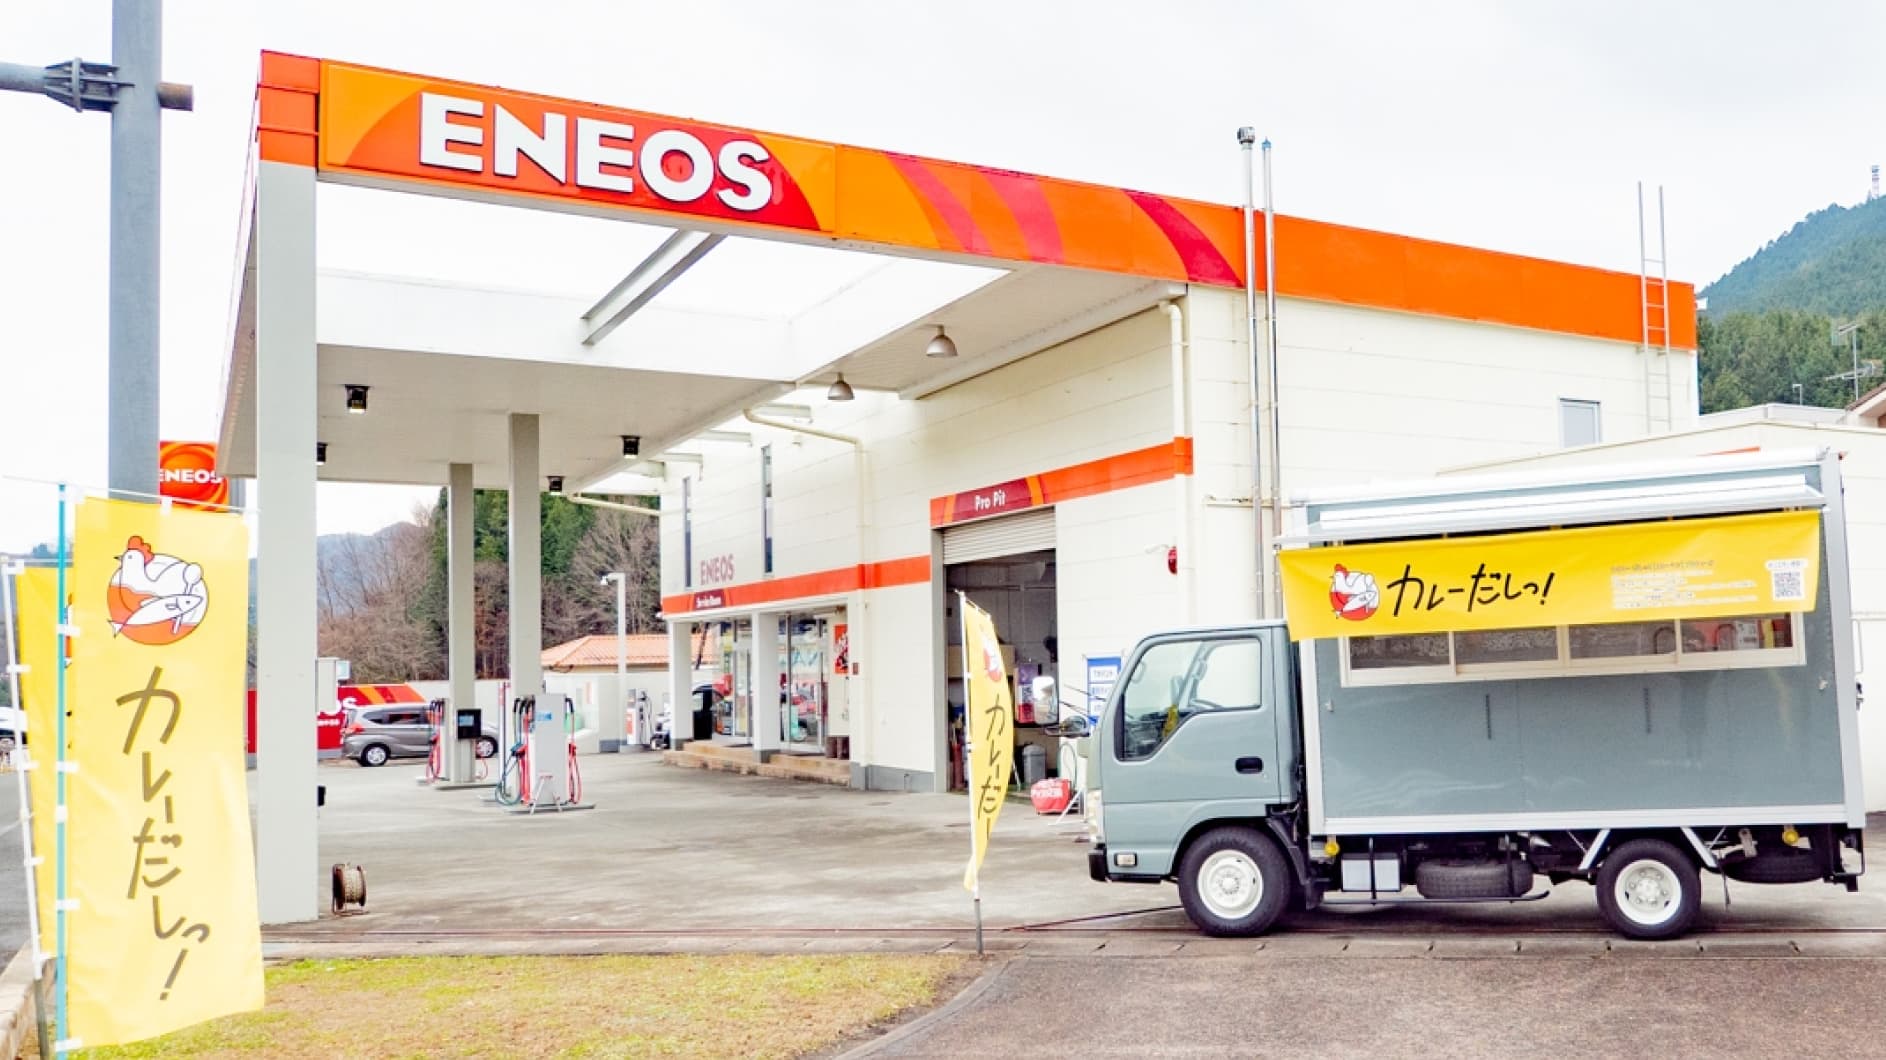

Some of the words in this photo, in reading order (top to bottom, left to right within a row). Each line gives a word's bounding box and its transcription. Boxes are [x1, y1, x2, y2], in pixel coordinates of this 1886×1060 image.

[419, 91, 773, 212] ENEOS
[975, 494, 991, 511] Pro
[993, 490, 1006, 507] Pit
[700, 554, 735, 585] ENEOS
